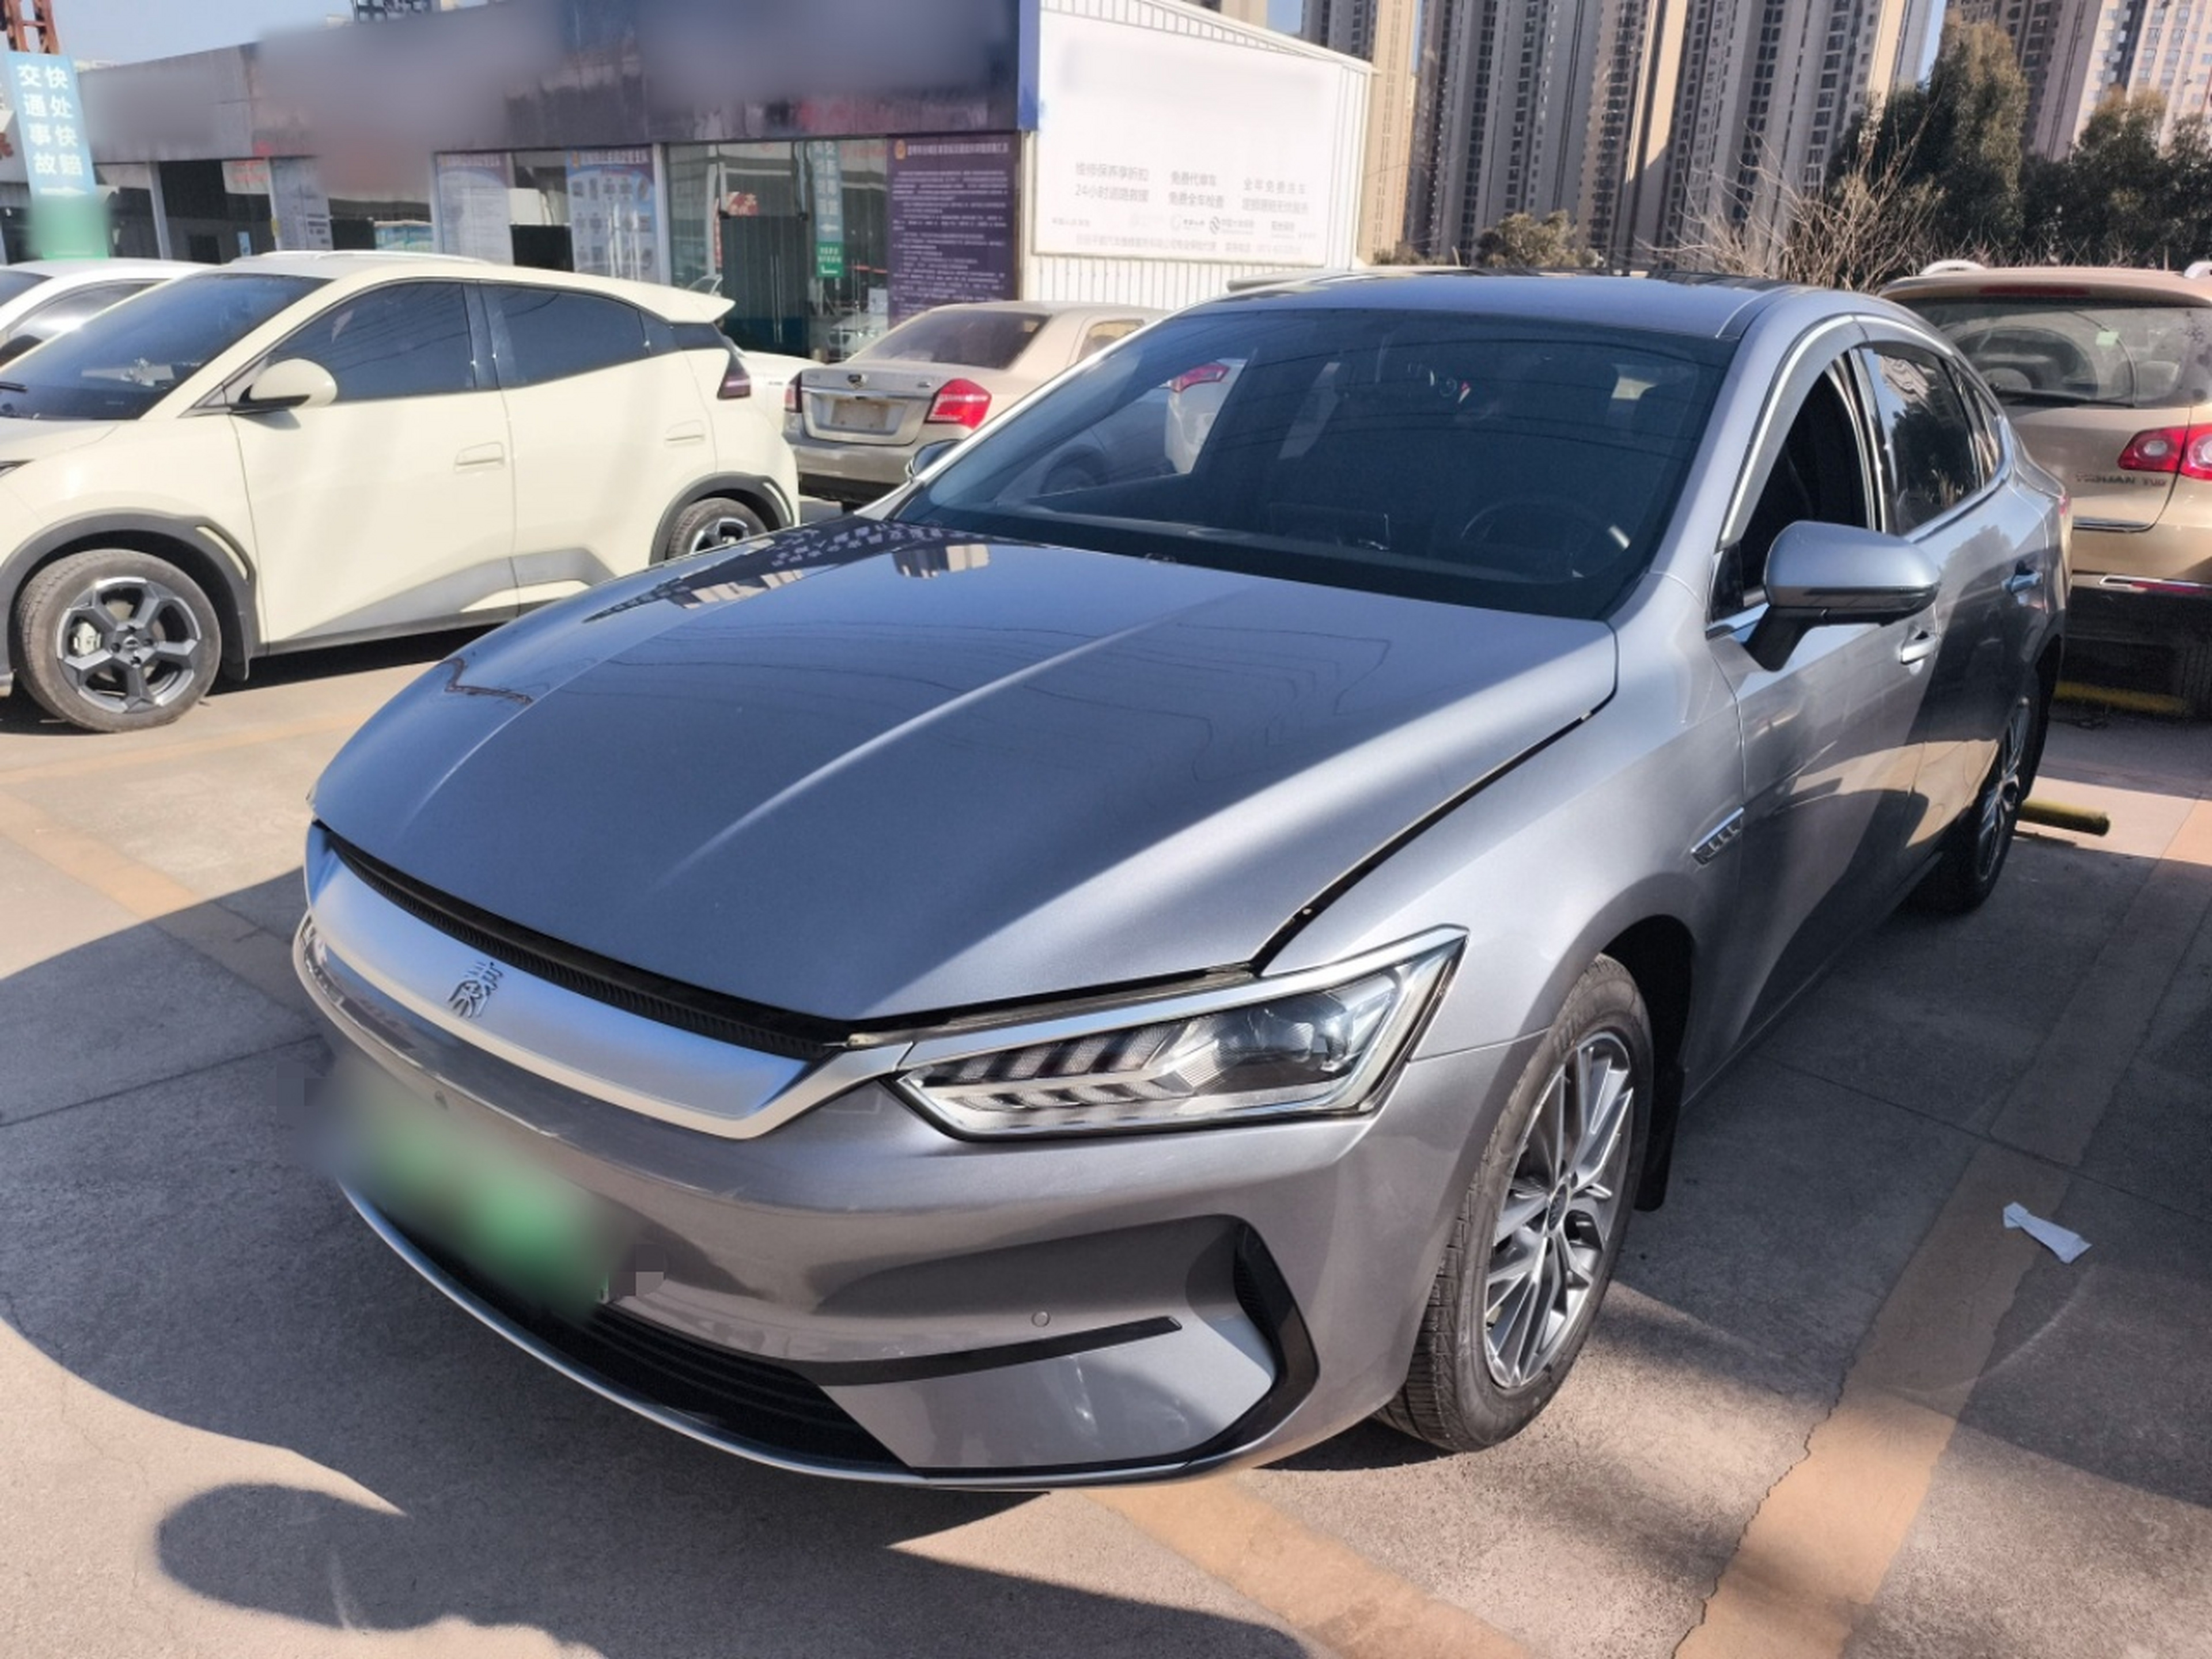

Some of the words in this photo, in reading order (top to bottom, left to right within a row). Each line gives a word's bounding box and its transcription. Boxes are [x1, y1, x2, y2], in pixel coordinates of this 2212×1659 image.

[16, 63, 58, 175] 交通事故
[44, 66, 84, 175] 快处快赔
